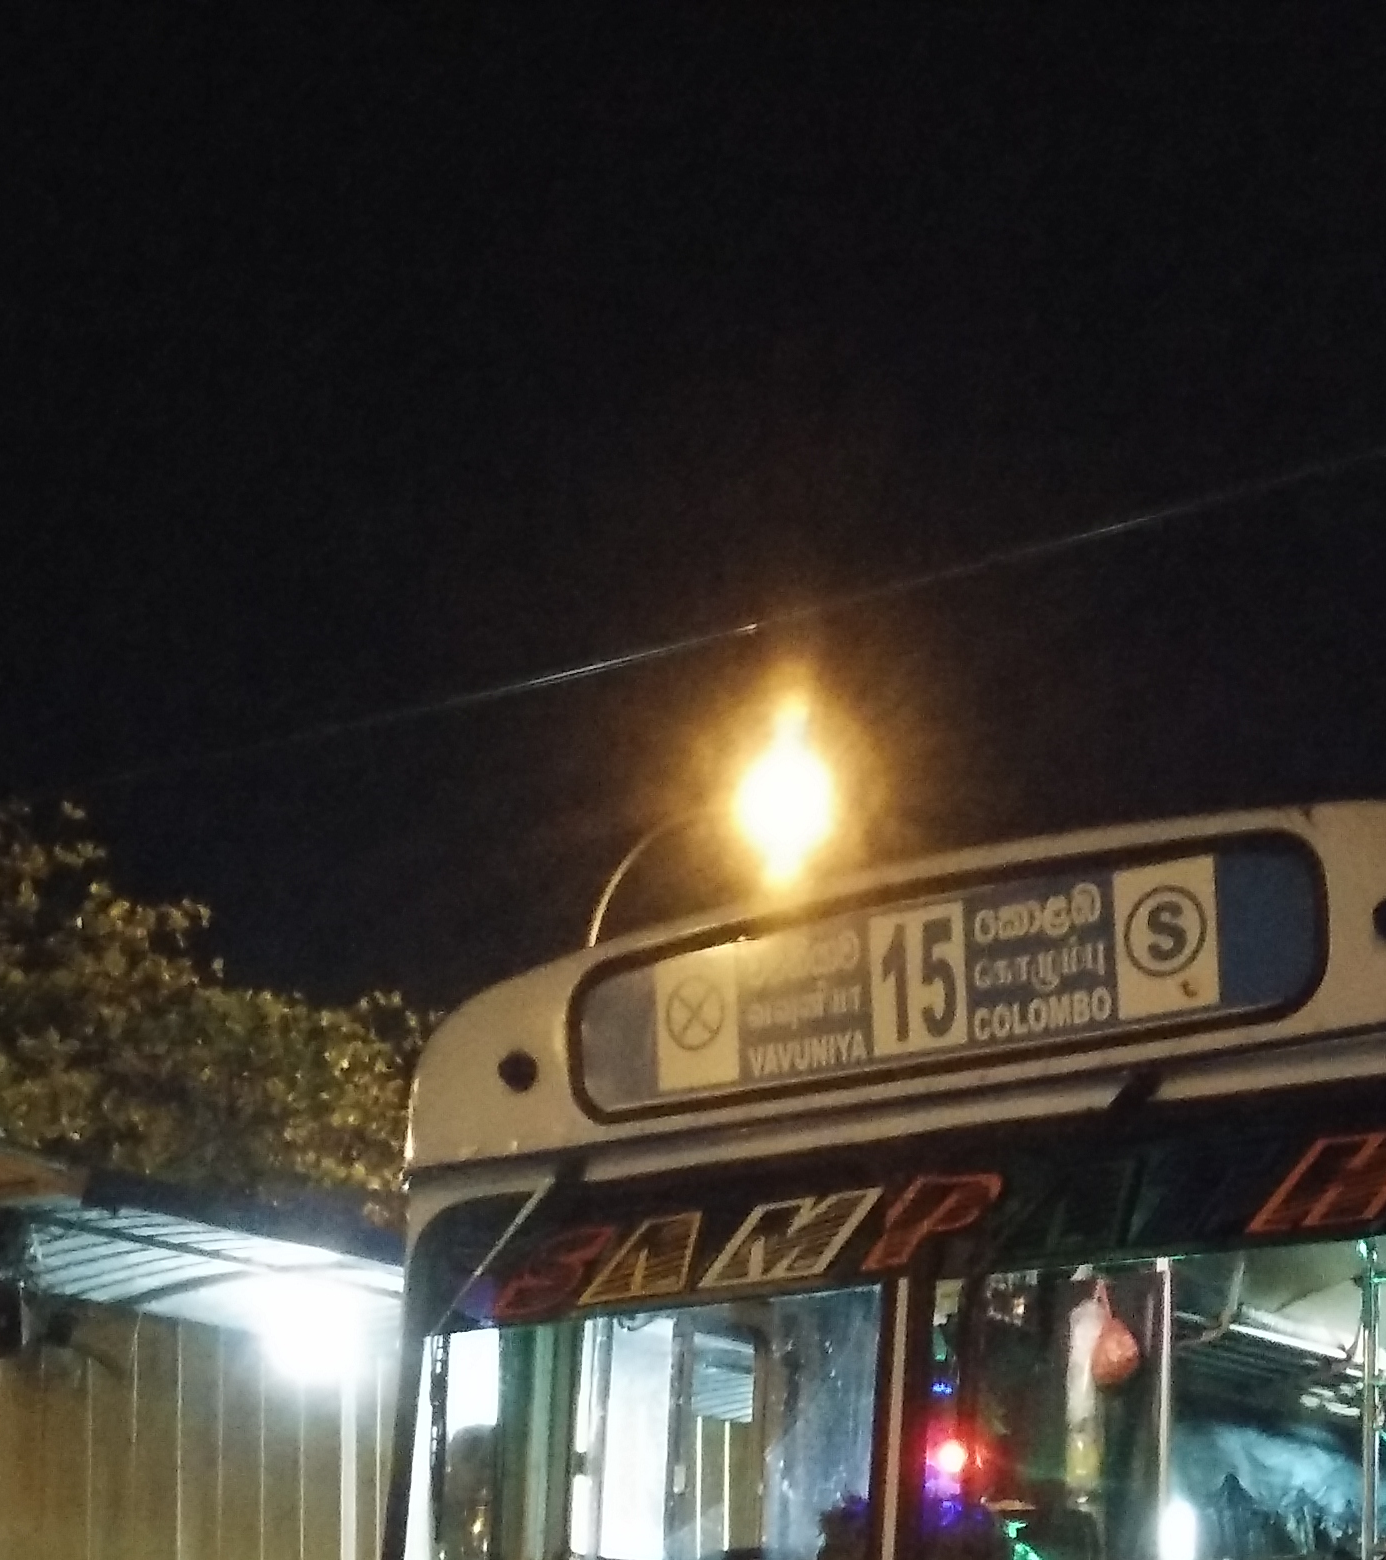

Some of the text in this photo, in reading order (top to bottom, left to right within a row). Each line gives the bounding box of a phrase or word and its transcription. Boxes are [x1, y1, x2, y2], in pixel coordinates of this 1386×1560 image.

[1147, 900, 1188, 961] S
[881, 916, 957, 1043] 15
[974, 987, 1112, 1041] COLOMBO
[747, 1029, 868, 1078] VAVUNIYA
